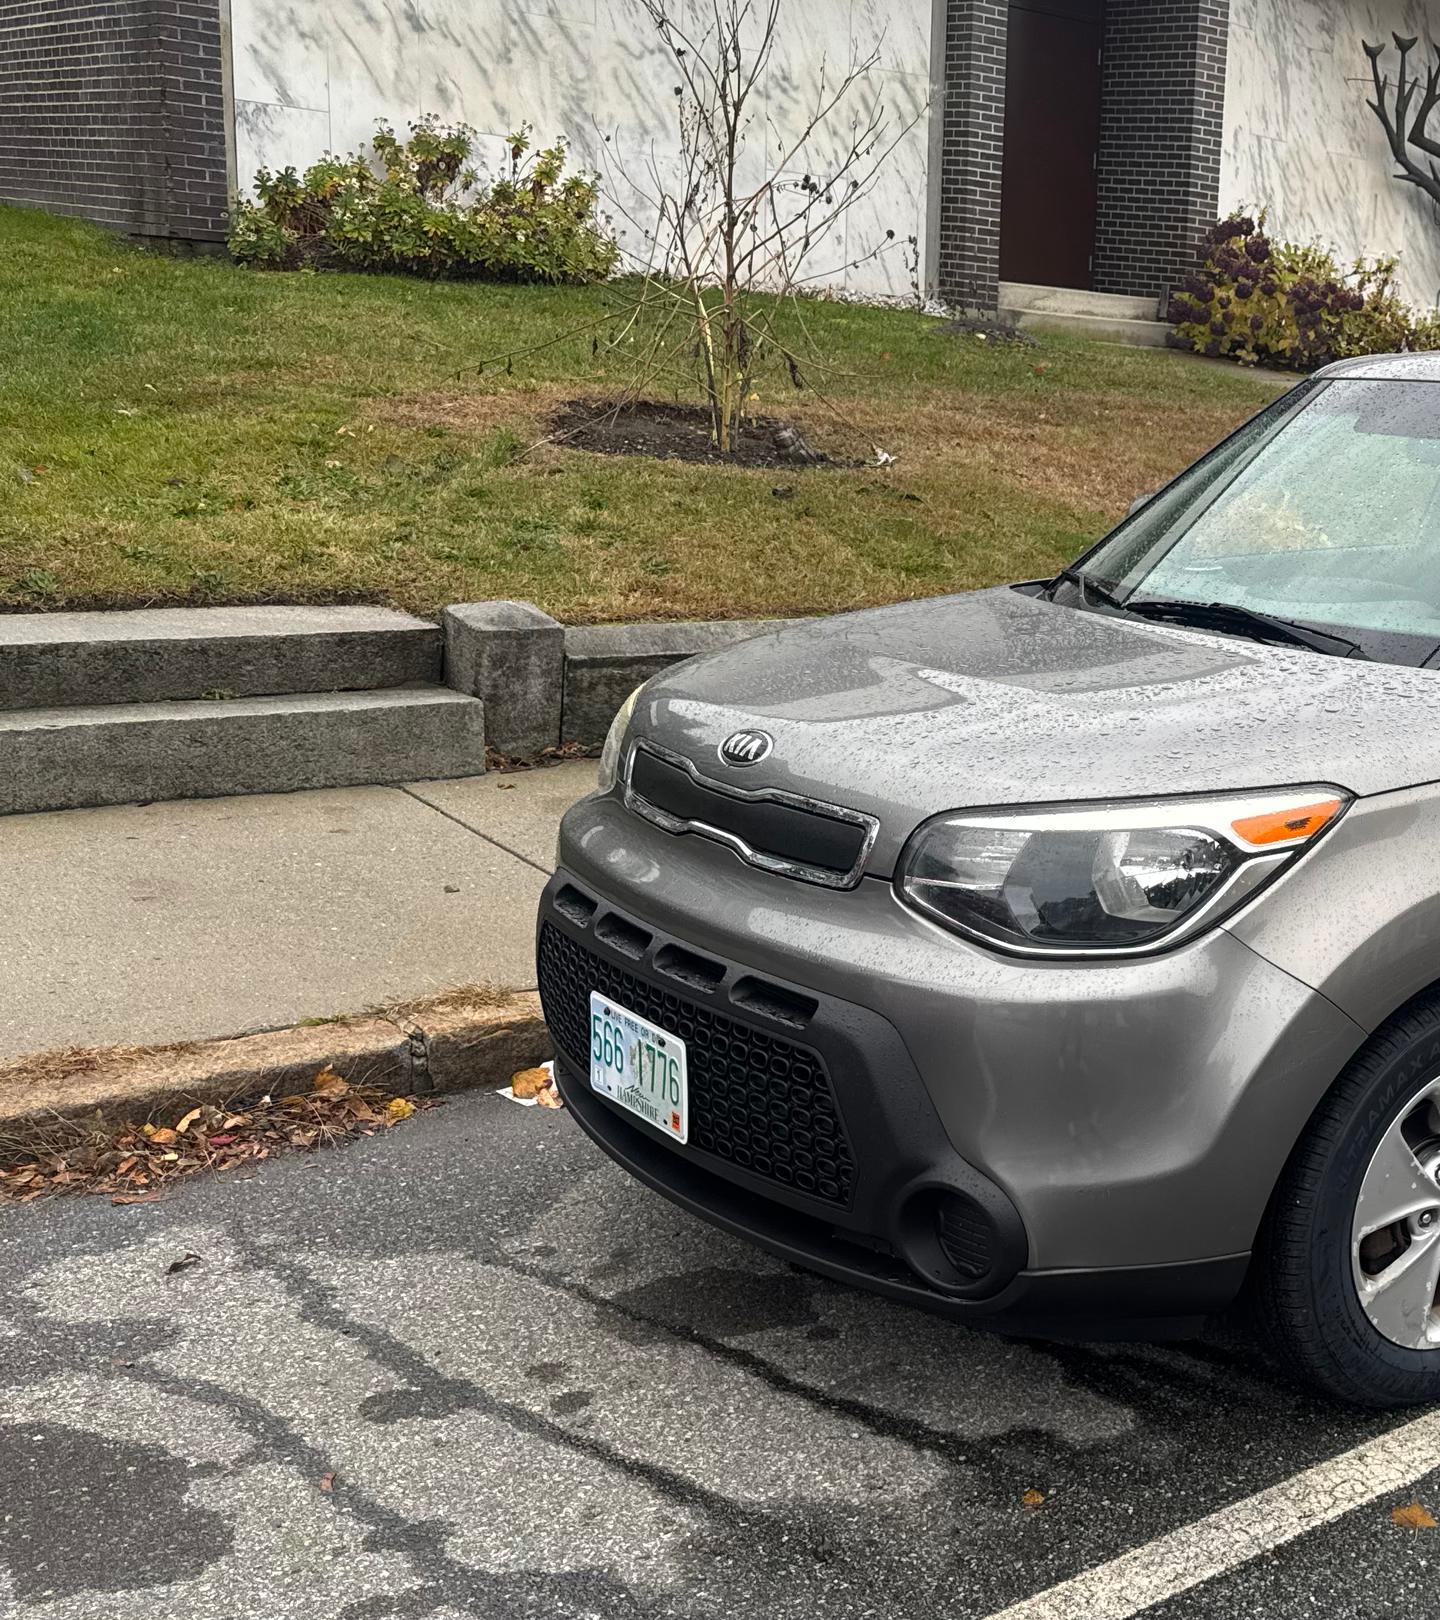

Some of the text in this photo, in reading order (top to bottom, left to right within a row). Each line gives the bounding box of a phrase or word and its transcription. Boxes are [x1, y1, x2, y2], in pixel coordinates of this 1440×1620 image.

[723, 733, 762, 760] KIA
[624, 1017, 639, 1034] FREE
[640, 1027, 649, 1039] OR
[593, 1014, 680, 1106] 566 1776
[617, 1085, 660, 1121] HAMPSHIRE
